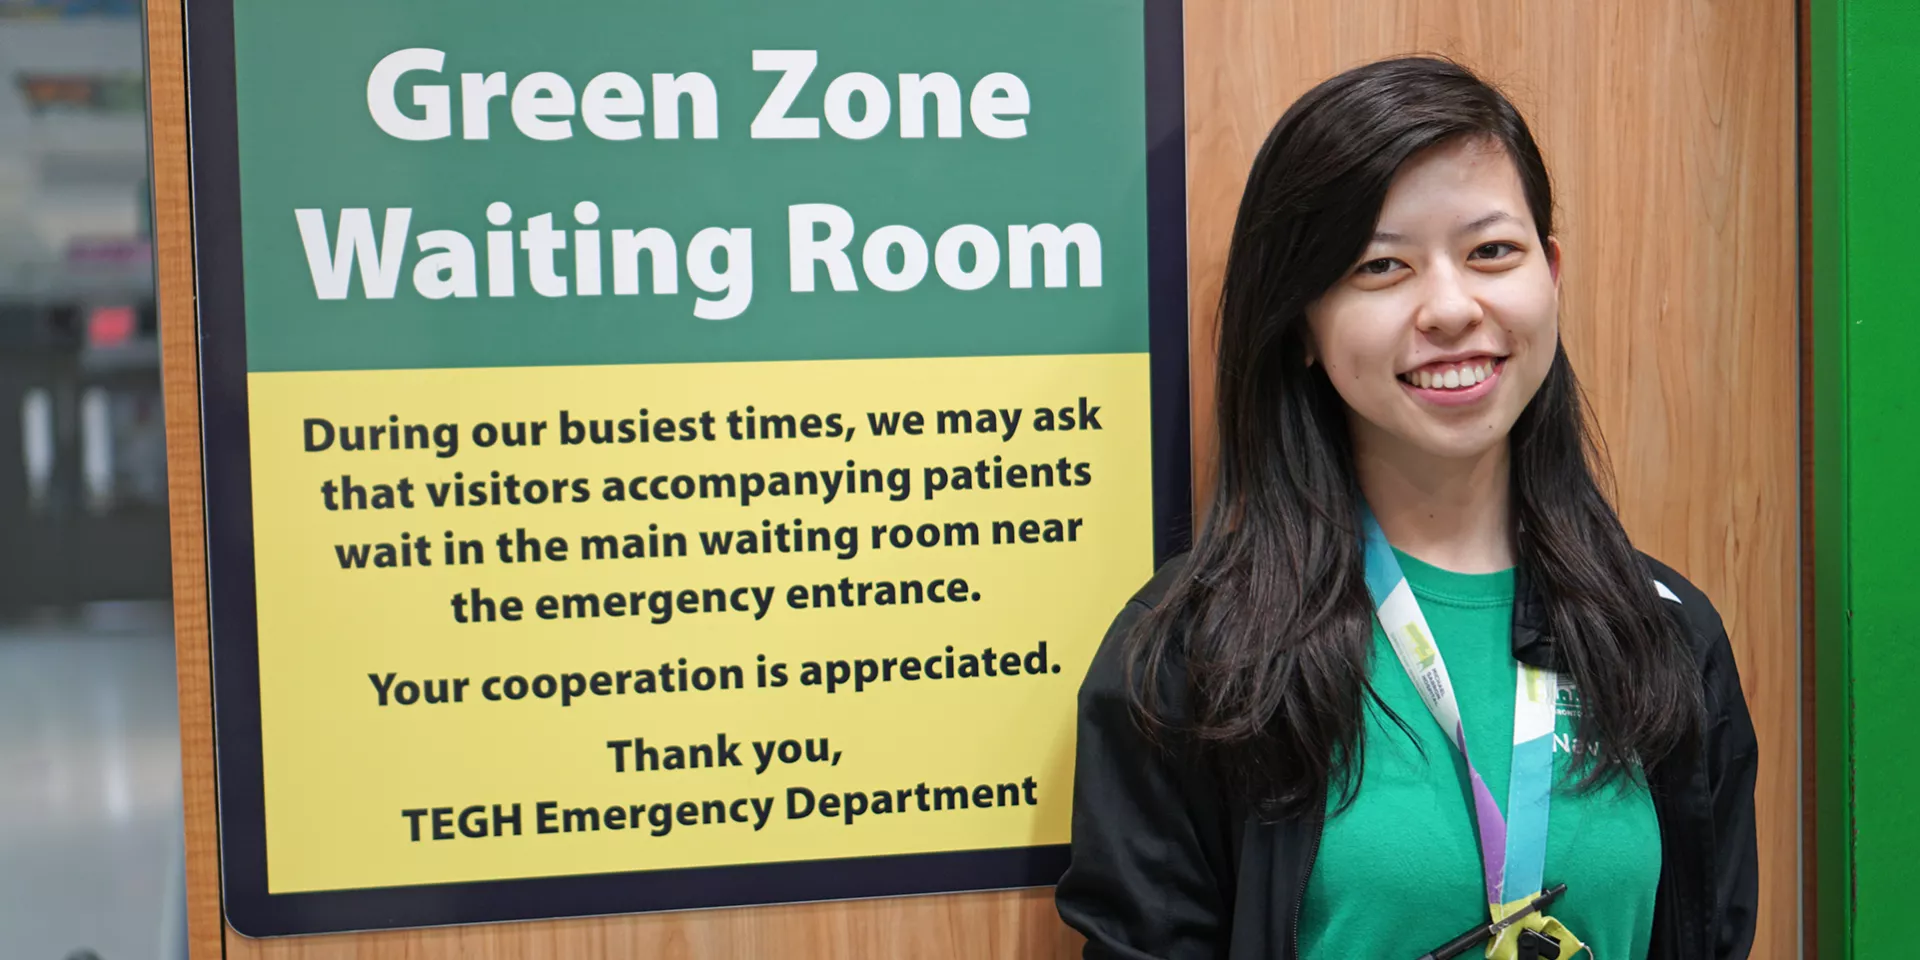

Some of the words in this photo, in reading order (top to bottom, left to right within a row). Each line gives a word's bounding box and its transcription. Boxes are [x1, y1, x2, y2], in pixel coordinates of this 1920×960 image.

[367, 48, 719, 141] Green
[750, 50, 1030, 141] Zone
[294, 201, 754, 320] Waiting
[788, 203, 1103, 292] Room
[303, 414, 458, 459] During
[472, 421, 547, 447] our
[559, 409, 716, 445] busiest
[726, 405, 856, 442] times,
[867, 411, 925, 436] we
[937, 408, 1023, 443] may
[1033, 396, 1103, 432] ask
[321, 475, 415, 510] that
[426, 470, 591, 507] visitors
[602, 460, 911, 506] accompanying
[924, 455, 1092, 500] patients
[335, 532, 432, 568] wait
[444, 531, 484, 565] in
[496, 528, 569, 563] the
[581, 524, 687, 560] main
[700, 514, 858, 559] waiting
[871, 522, 980, 549] room
[992, 518, 1083, 544] near
[451, 587, 524, 624] the
[536, 587, 775, 625] emergency
[786, 577, 981, 609] entrance.
[368, 672, 470, 706] Your
[482, 657, 744, 707] cooperation
[757, 653, 789, 688] is
[800, 640, 1062, 693] appreciated.
[607, 733, 743, 773] Thank
[752, 738, 842, 775] you,
[402, 803, 522, 842] TEGH
[537, 797, 775, 837] Emergency
[786, 776, 1038, 826] Department
